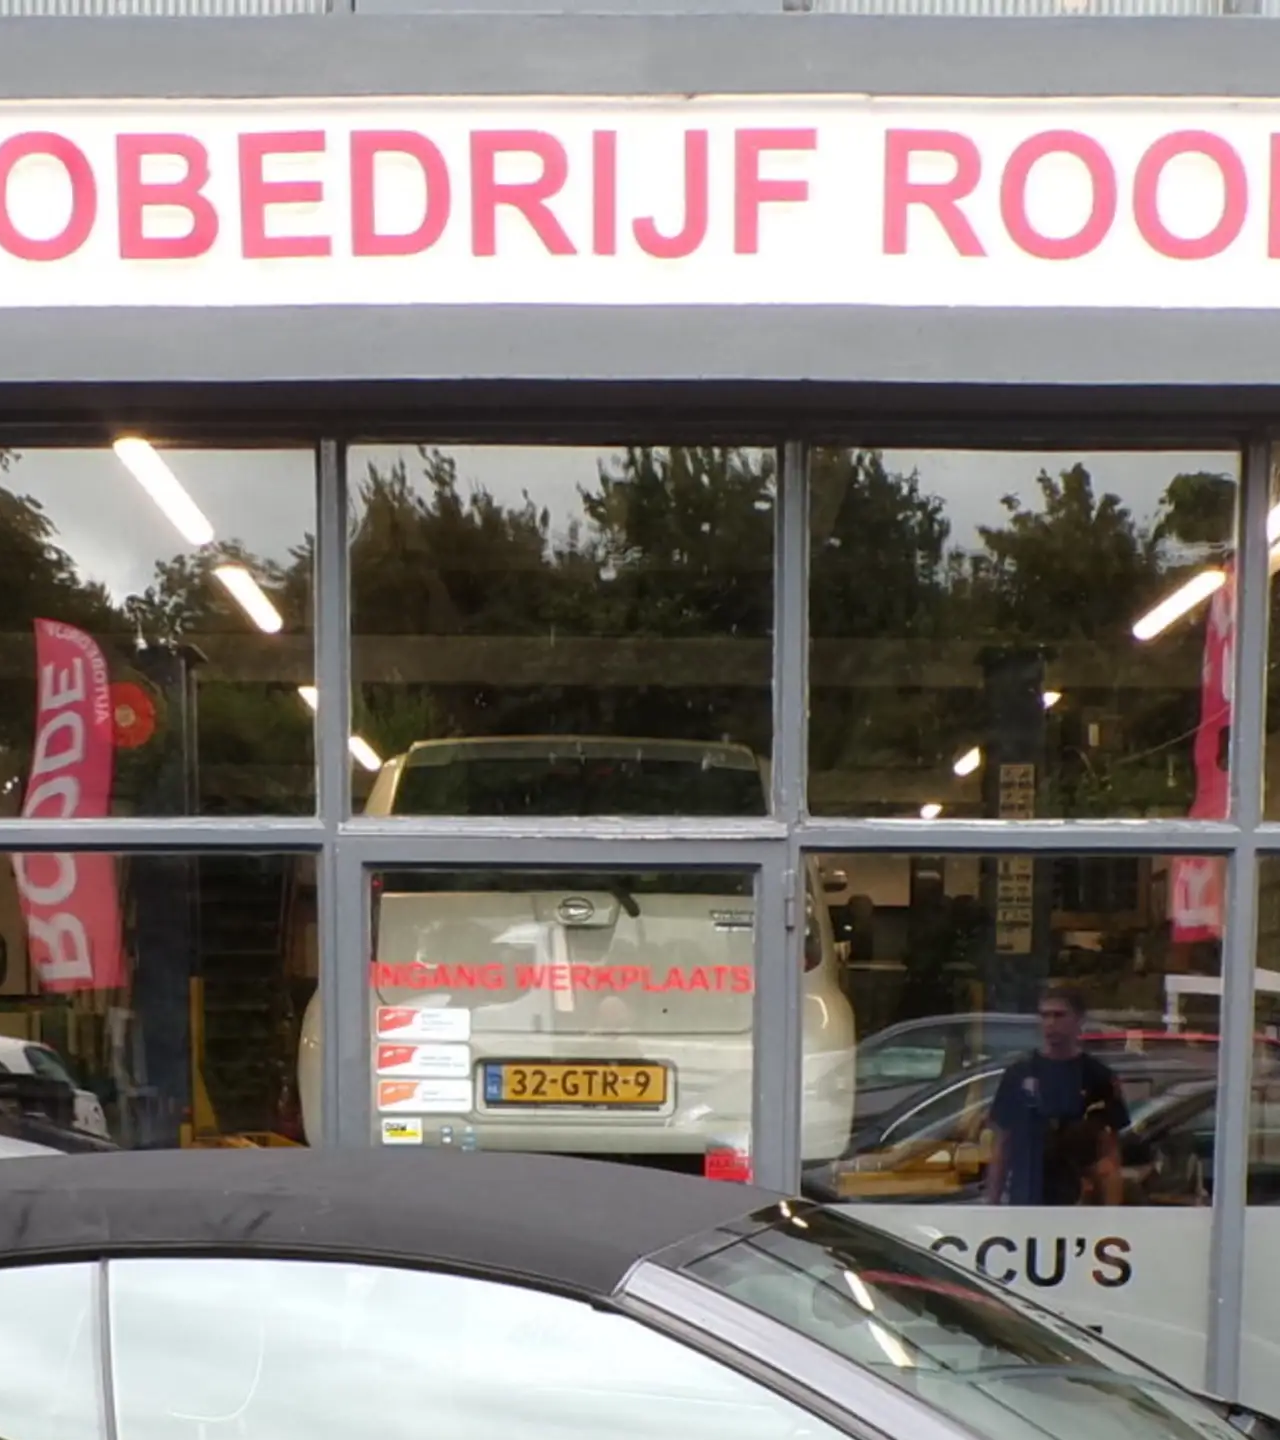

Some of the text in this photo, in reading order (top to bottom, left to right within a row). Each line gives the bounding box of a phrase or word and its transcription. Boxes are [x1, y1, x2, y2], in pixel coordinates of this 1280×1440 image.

[369, 960, 754, 994] INGANG WERKPLAATS
[510, 1069, 651, 1098] 32-GTR-9
